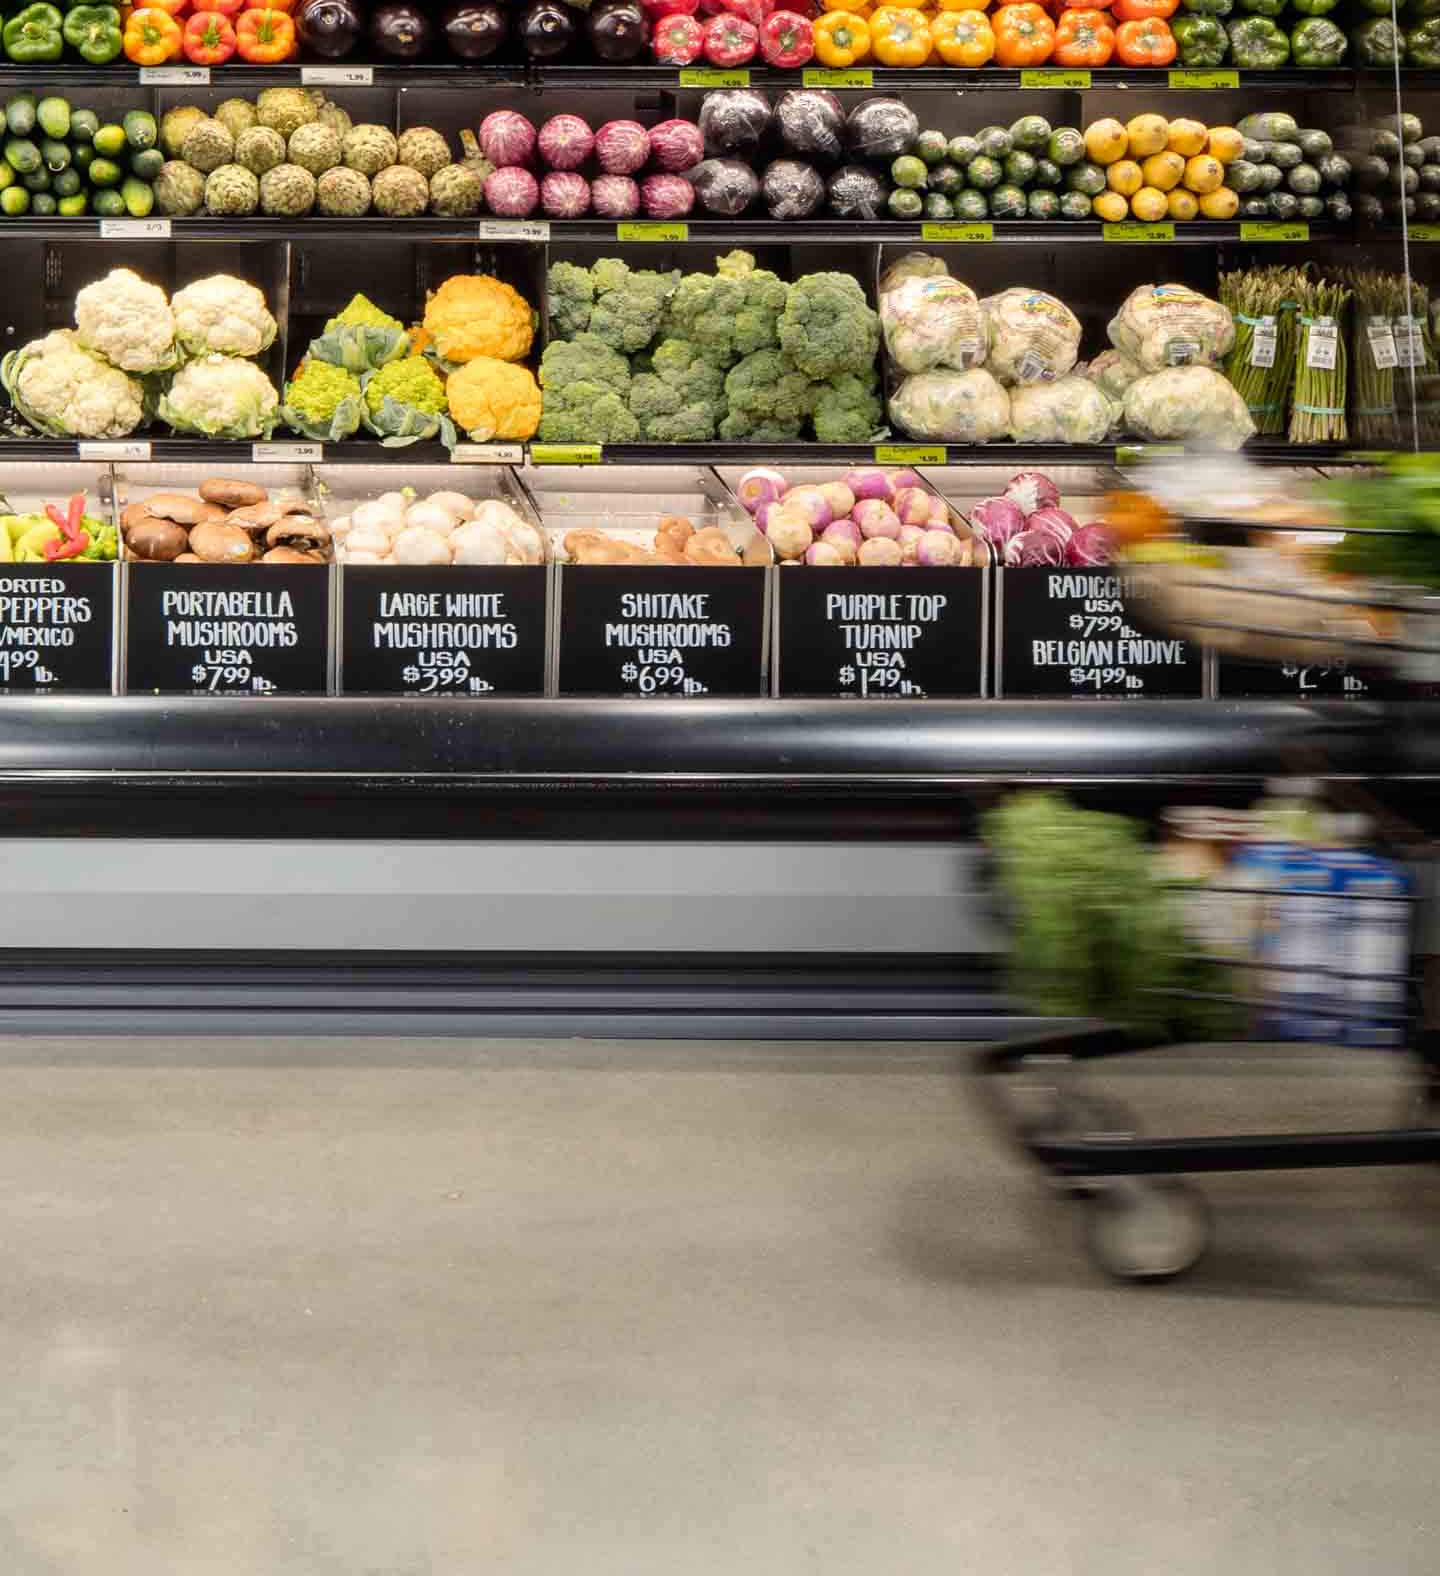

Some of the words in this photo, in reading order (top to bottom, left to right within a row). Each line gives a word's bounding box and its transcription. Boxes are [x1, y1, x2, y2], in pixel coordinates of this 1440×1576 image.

[162, 589, 295, 618] PORTABELLA
[379, 591, 442, 618] LARGE
[445, 592, 507, 619] WHITE
[620, 592, 710, 620] SHITAKE
[826, 593, 903, 621] PURPLE
[905, 594, 948, 622] TOP
[1084, 599, 1125, 613] USA
[167, 620, 299, 649] MUSHROOMS
[373, 622, 518, 650] MUSHROOMS
[605, 623, 731, 648] MUSHROOMS
[839, 624, 922, 650] TURNIP
[203, 649, 253, 666] USA
[418, 650, 471, 667] USA
[638, 648, 684, 665] USA
[855, 651, 906, 669] USA
[1032, 640, 1113, 665] BELGIAN
[1118, 639, 1187, 665] ENDIVE
